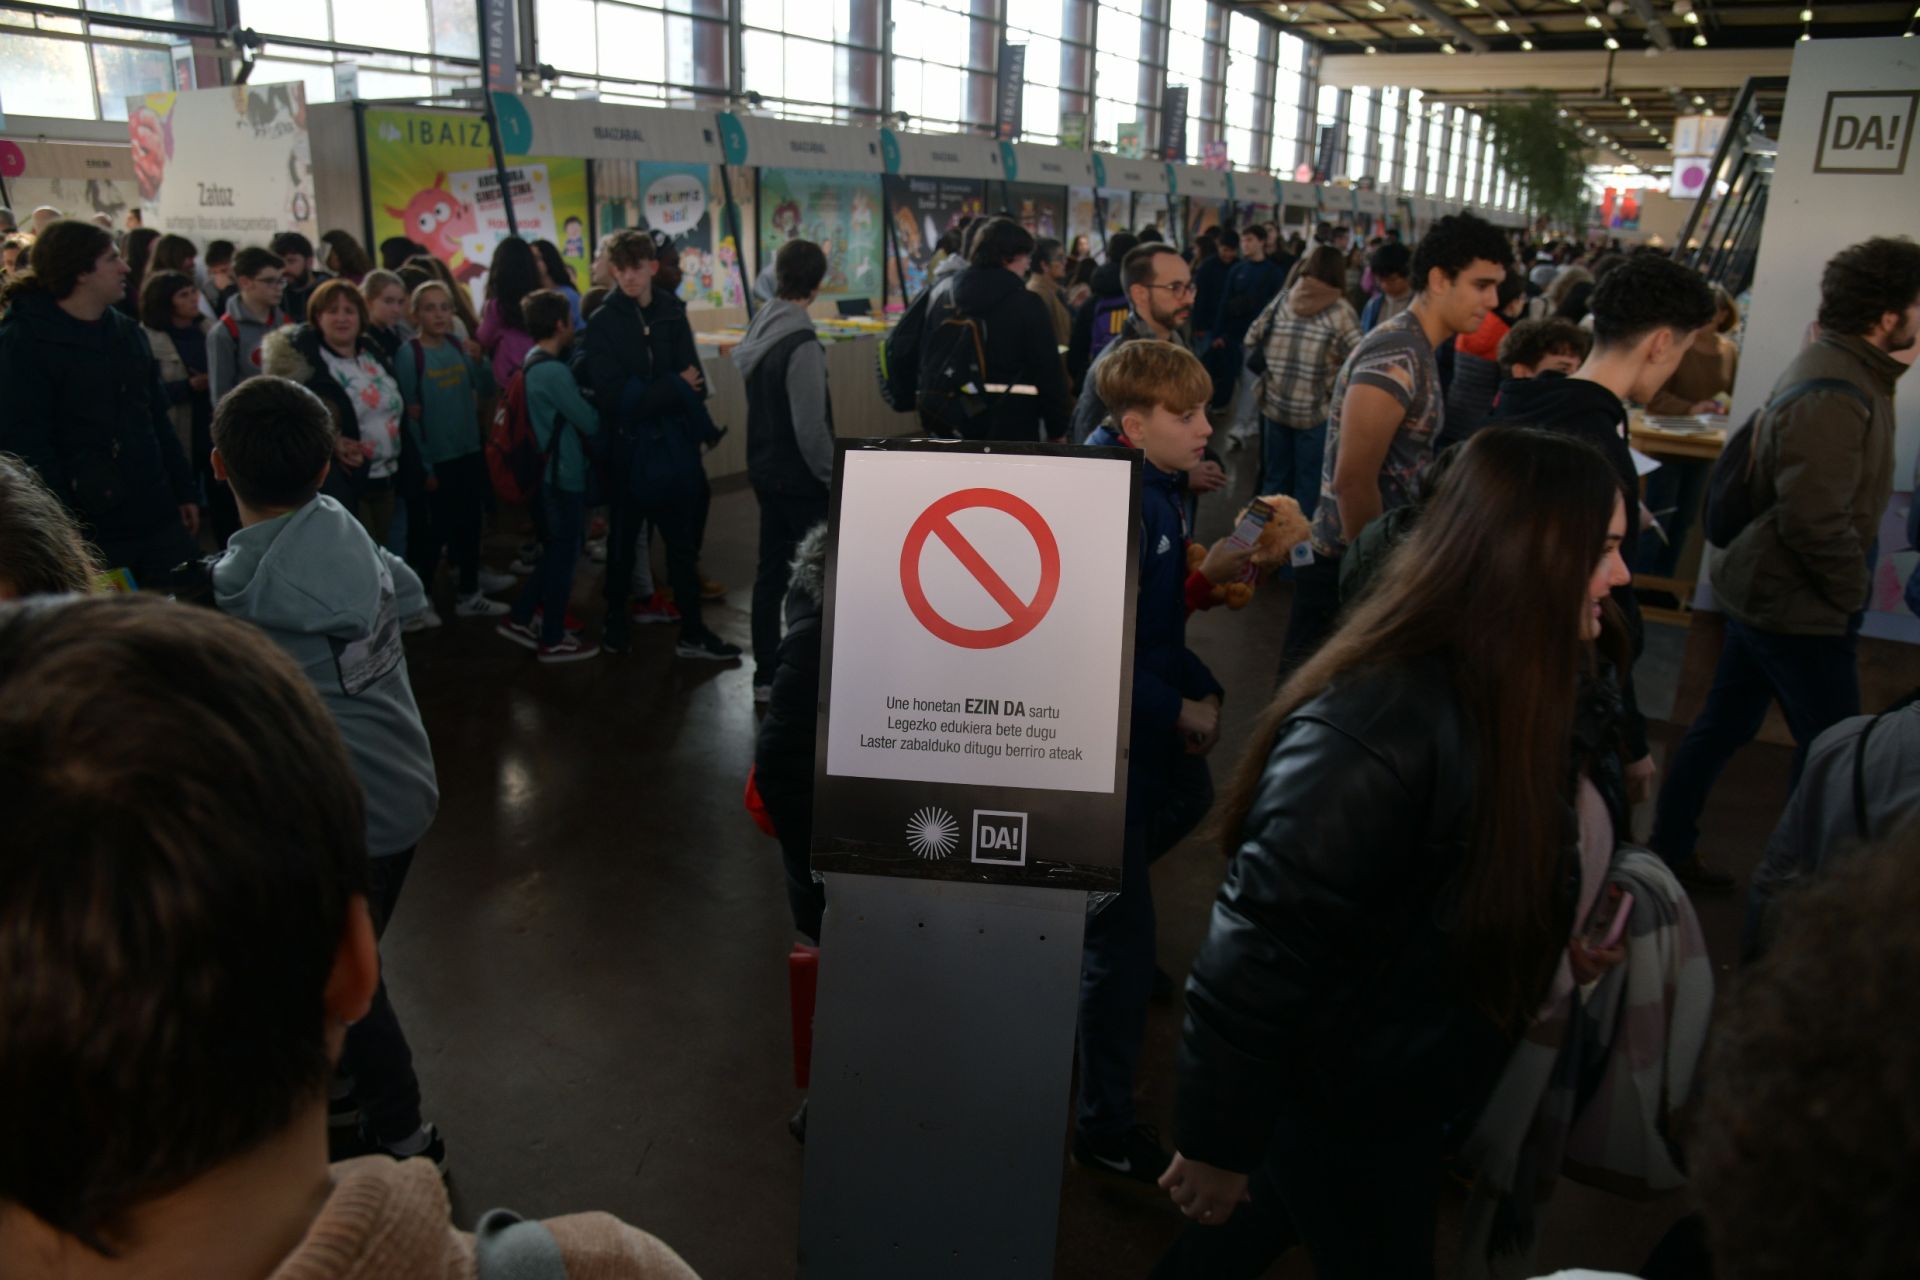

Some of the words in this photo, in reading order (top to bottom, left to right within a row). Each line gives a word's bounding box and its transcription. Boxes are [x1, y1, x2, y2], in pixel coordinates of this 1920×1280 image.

[510, 117, 520, 136] 1
[1831, 115, 1901, 150] DA!
[7, 154, 17, 166] 3
[197, 182, 235, 207] Zatoz
[886, 696, 909, 710] Une
[913, 698, 961, 713] honetan
[964, 698, 999, 715] EZIN
[1003, 700, 1026, 717] DA
[1028, 705, 1060, 719] sartu
[888, 716, 937, 734] Legezko
[940, 719, 992, 735] edukiera
[996, 722, 1022, 737] bete
[1026, 725, 1057, 741] dugu
[860, 734, 897, 749] Laster
[900, 737, 961, 754] zabalduko
[964, 741, 1002, 758] ditugu
[1005, 743, 1046, 759] berriro
[1049, 747, 1083, 761] ateak
[980, 825, 1019, 851] DA!
